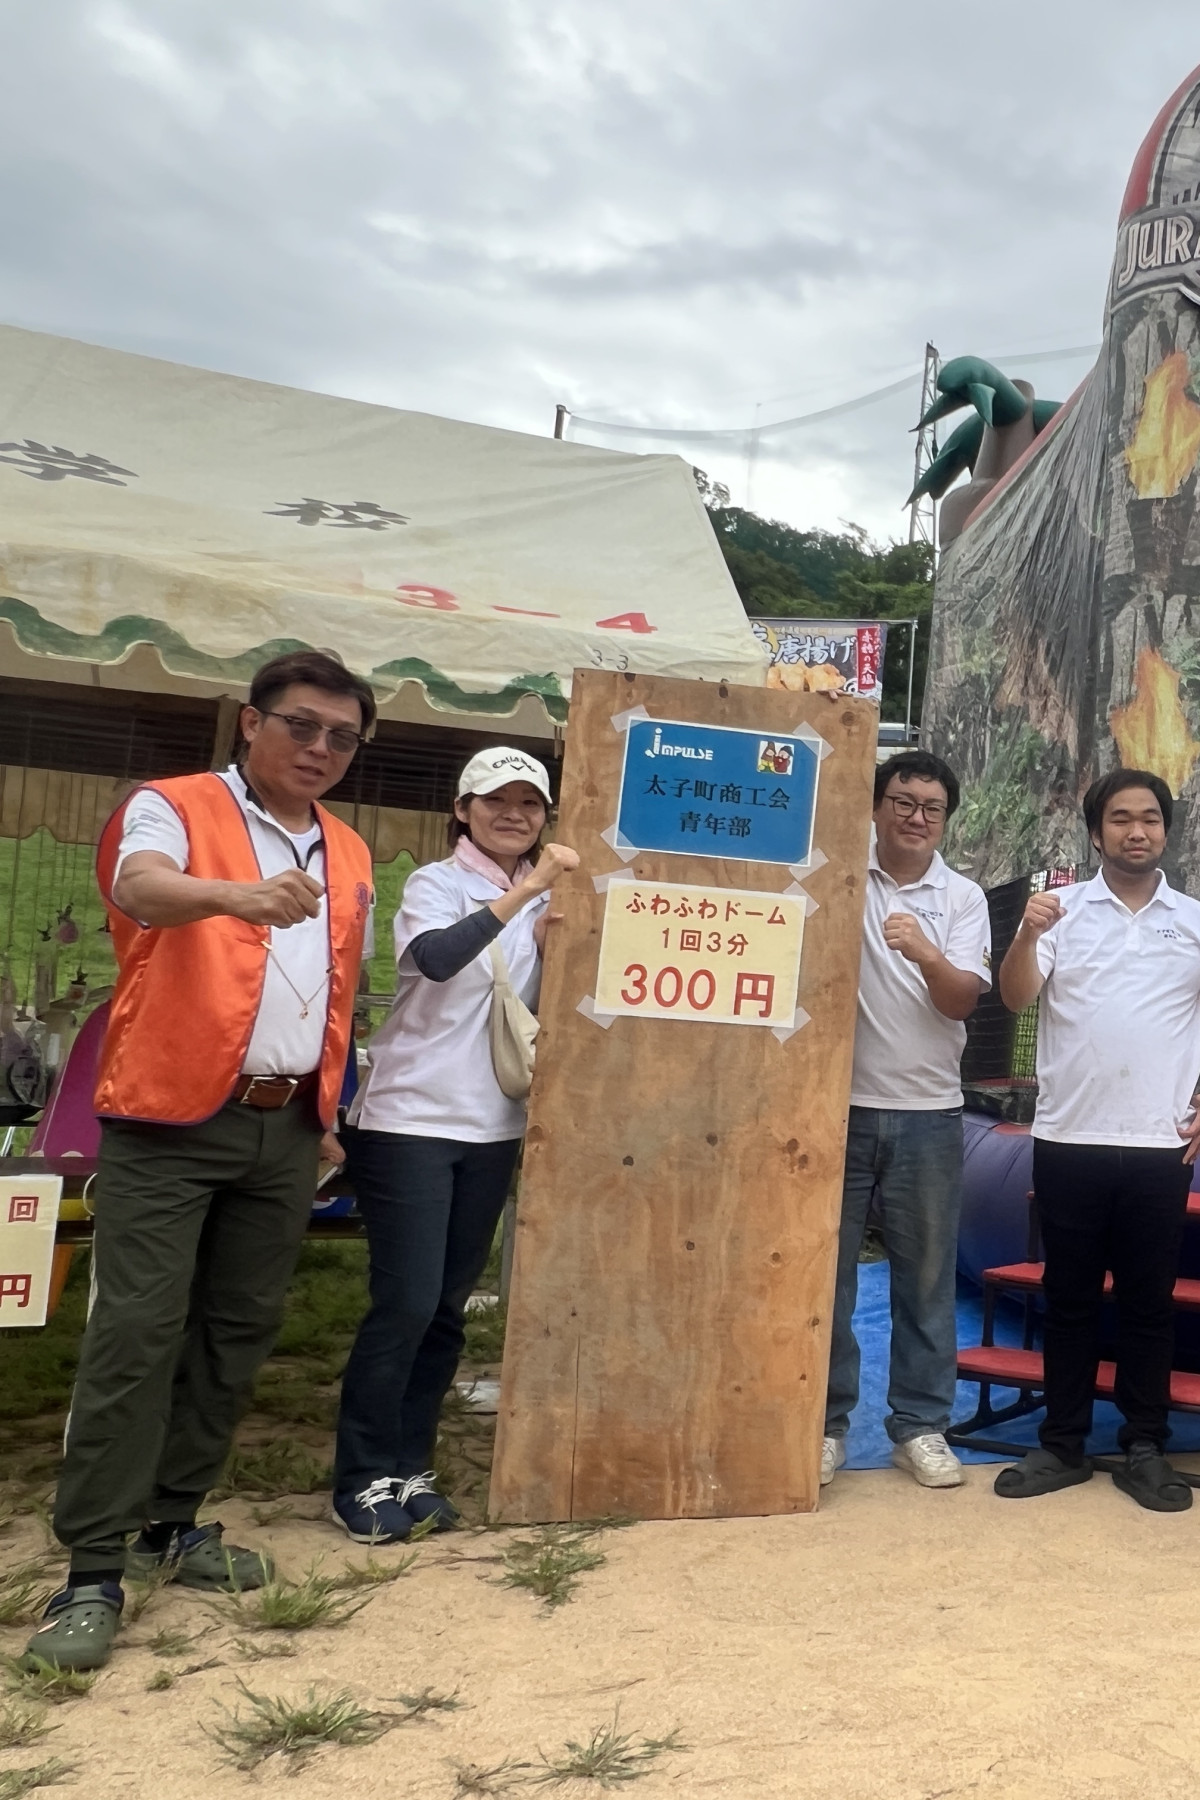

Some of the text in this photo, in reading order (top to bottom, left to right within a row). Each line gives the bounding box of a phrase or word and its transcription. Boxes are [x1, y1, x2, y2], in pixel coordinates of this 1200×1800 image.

[643, 774, 791, 810] 太子町商工会
[680, 811, 752, 838] 青年部
[626, 892, 786, 925] ふわふわドーム
[661, 927, 749, 956] 1回3分
[8, 1196, 39, 1223] 回
[0, 1274, 32, 1308] 円
